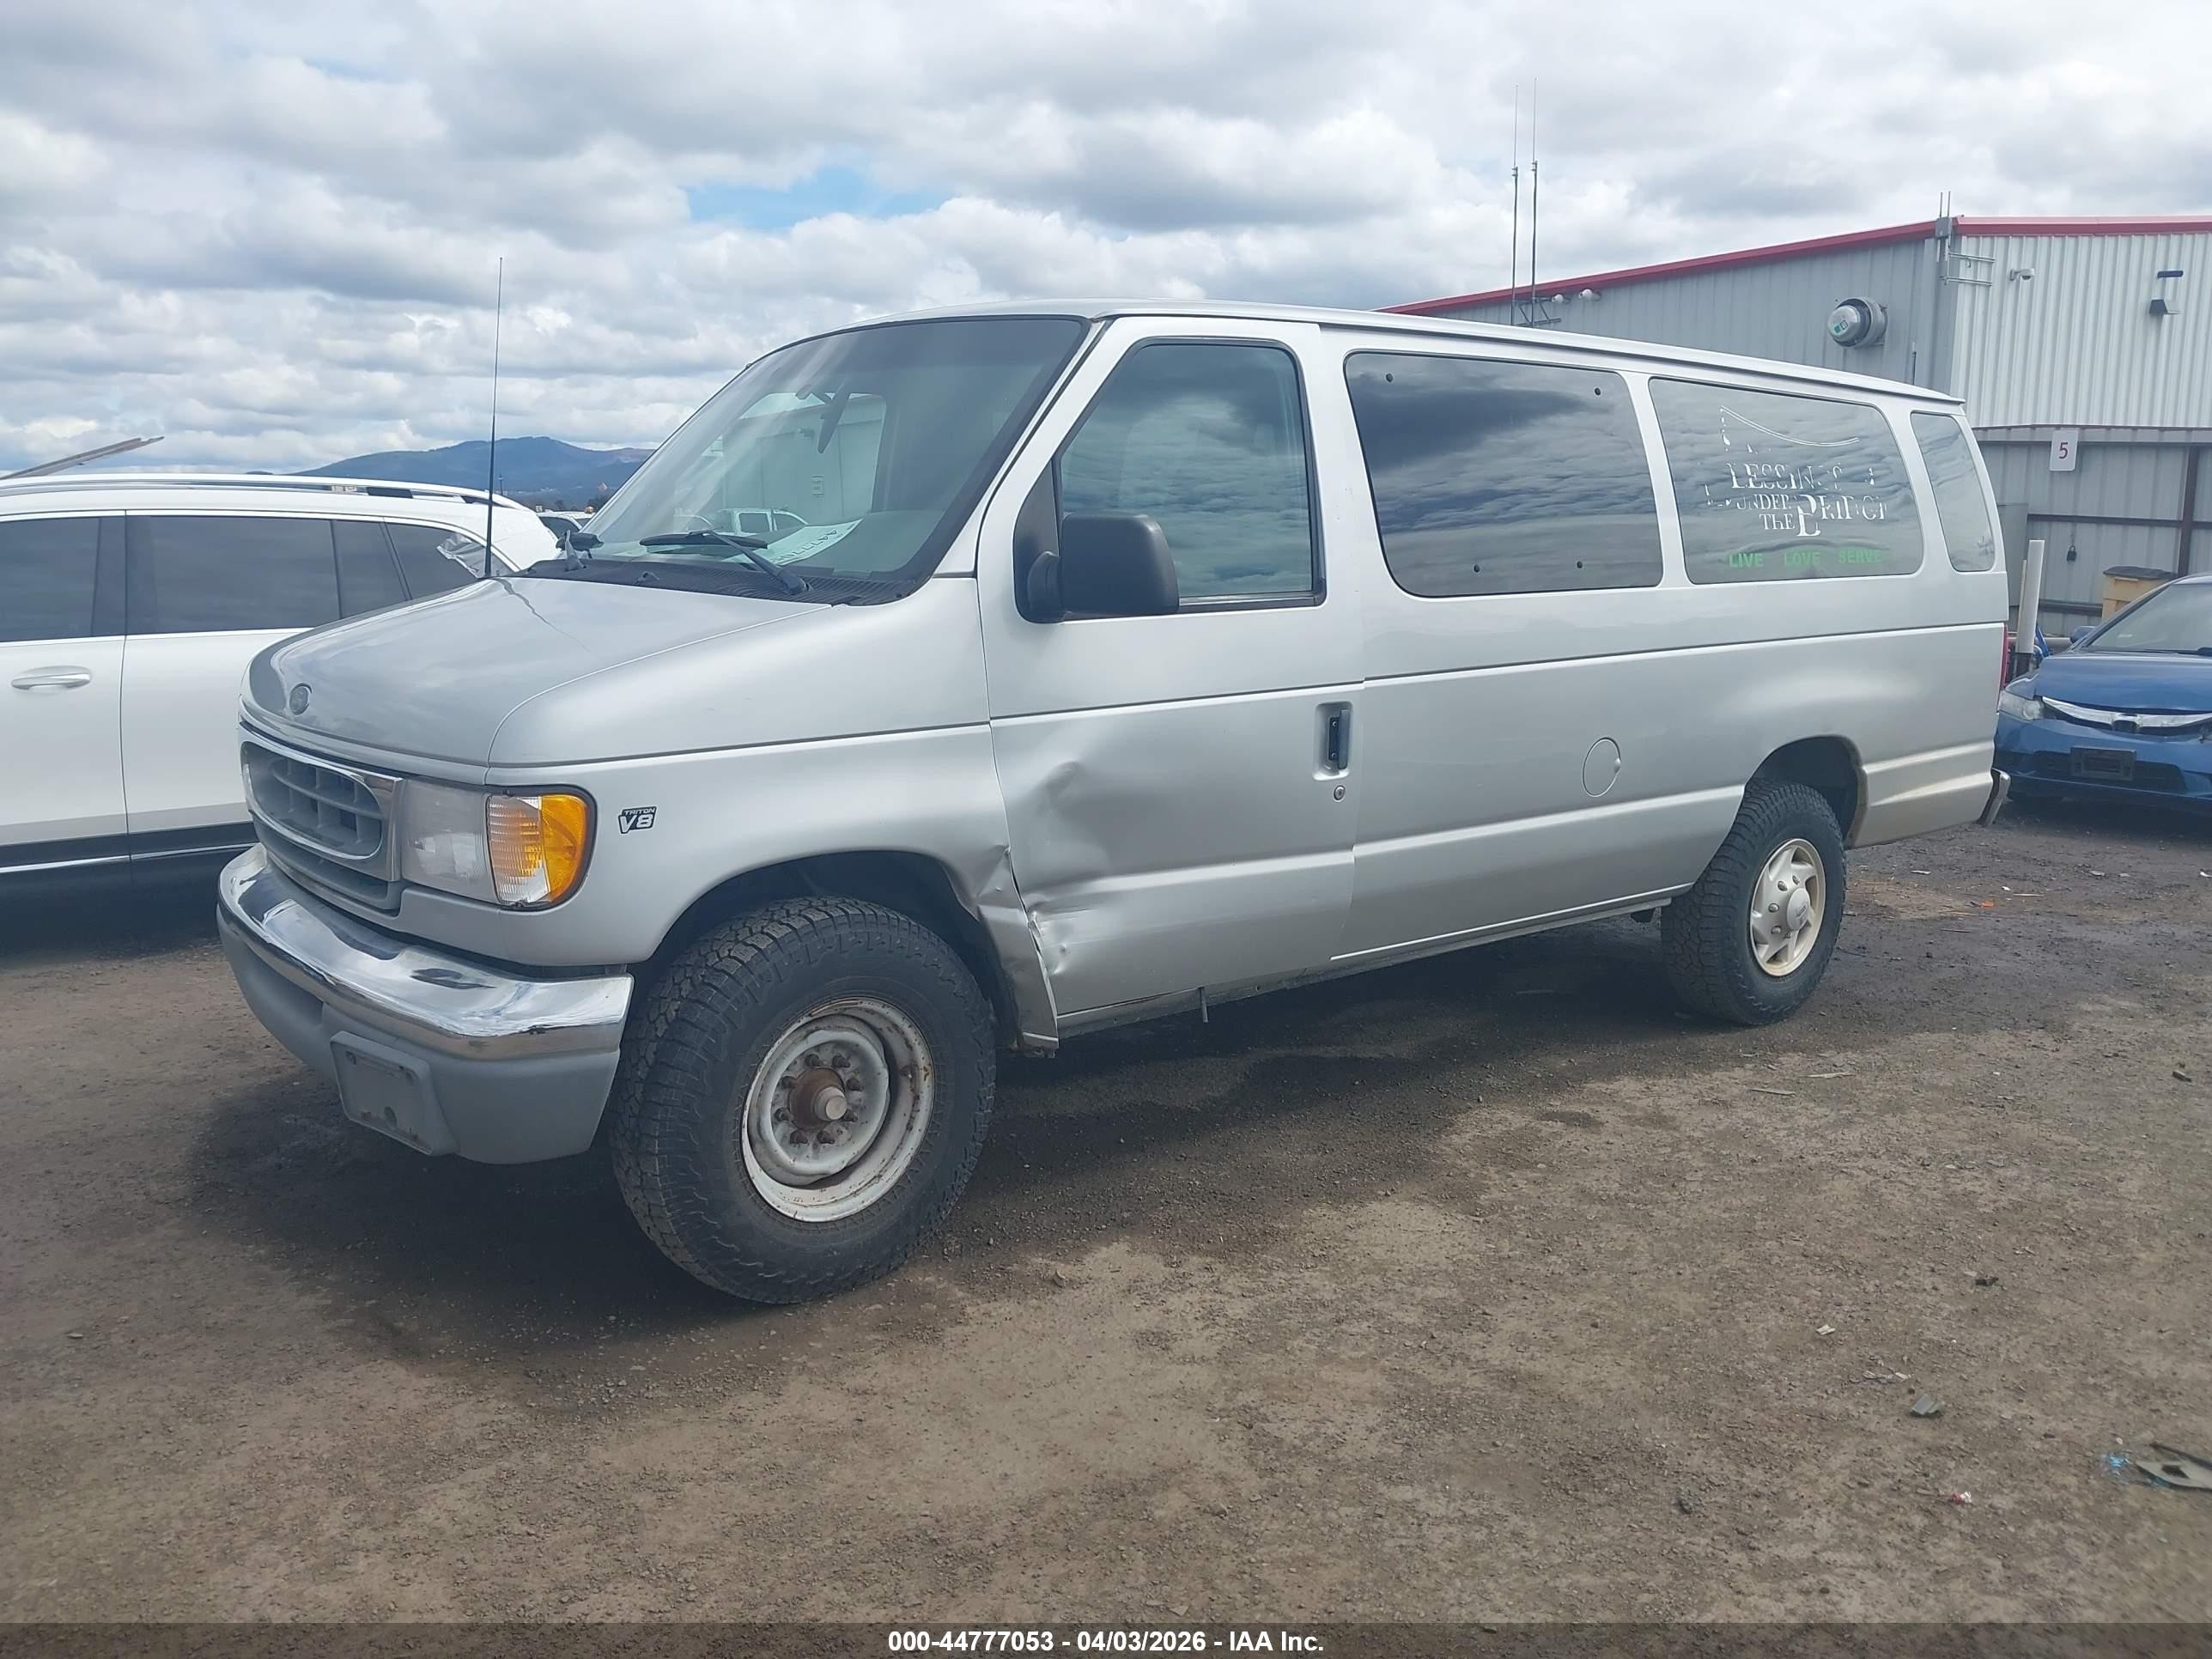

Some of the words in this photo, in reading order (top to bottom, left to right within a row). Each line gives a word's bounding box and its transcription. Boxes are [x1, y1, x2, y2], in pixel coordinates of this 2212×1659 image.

[2058, 441, 2069, 459] 5
[1729, 552, 1765, 568] LIVE
[1784, 550, 1821, 567] LOVE
[1838, 549, 1883, 564] SERVE
[623, 807, 655, 816] TRITON
[618, 813, 653, 834] V8
